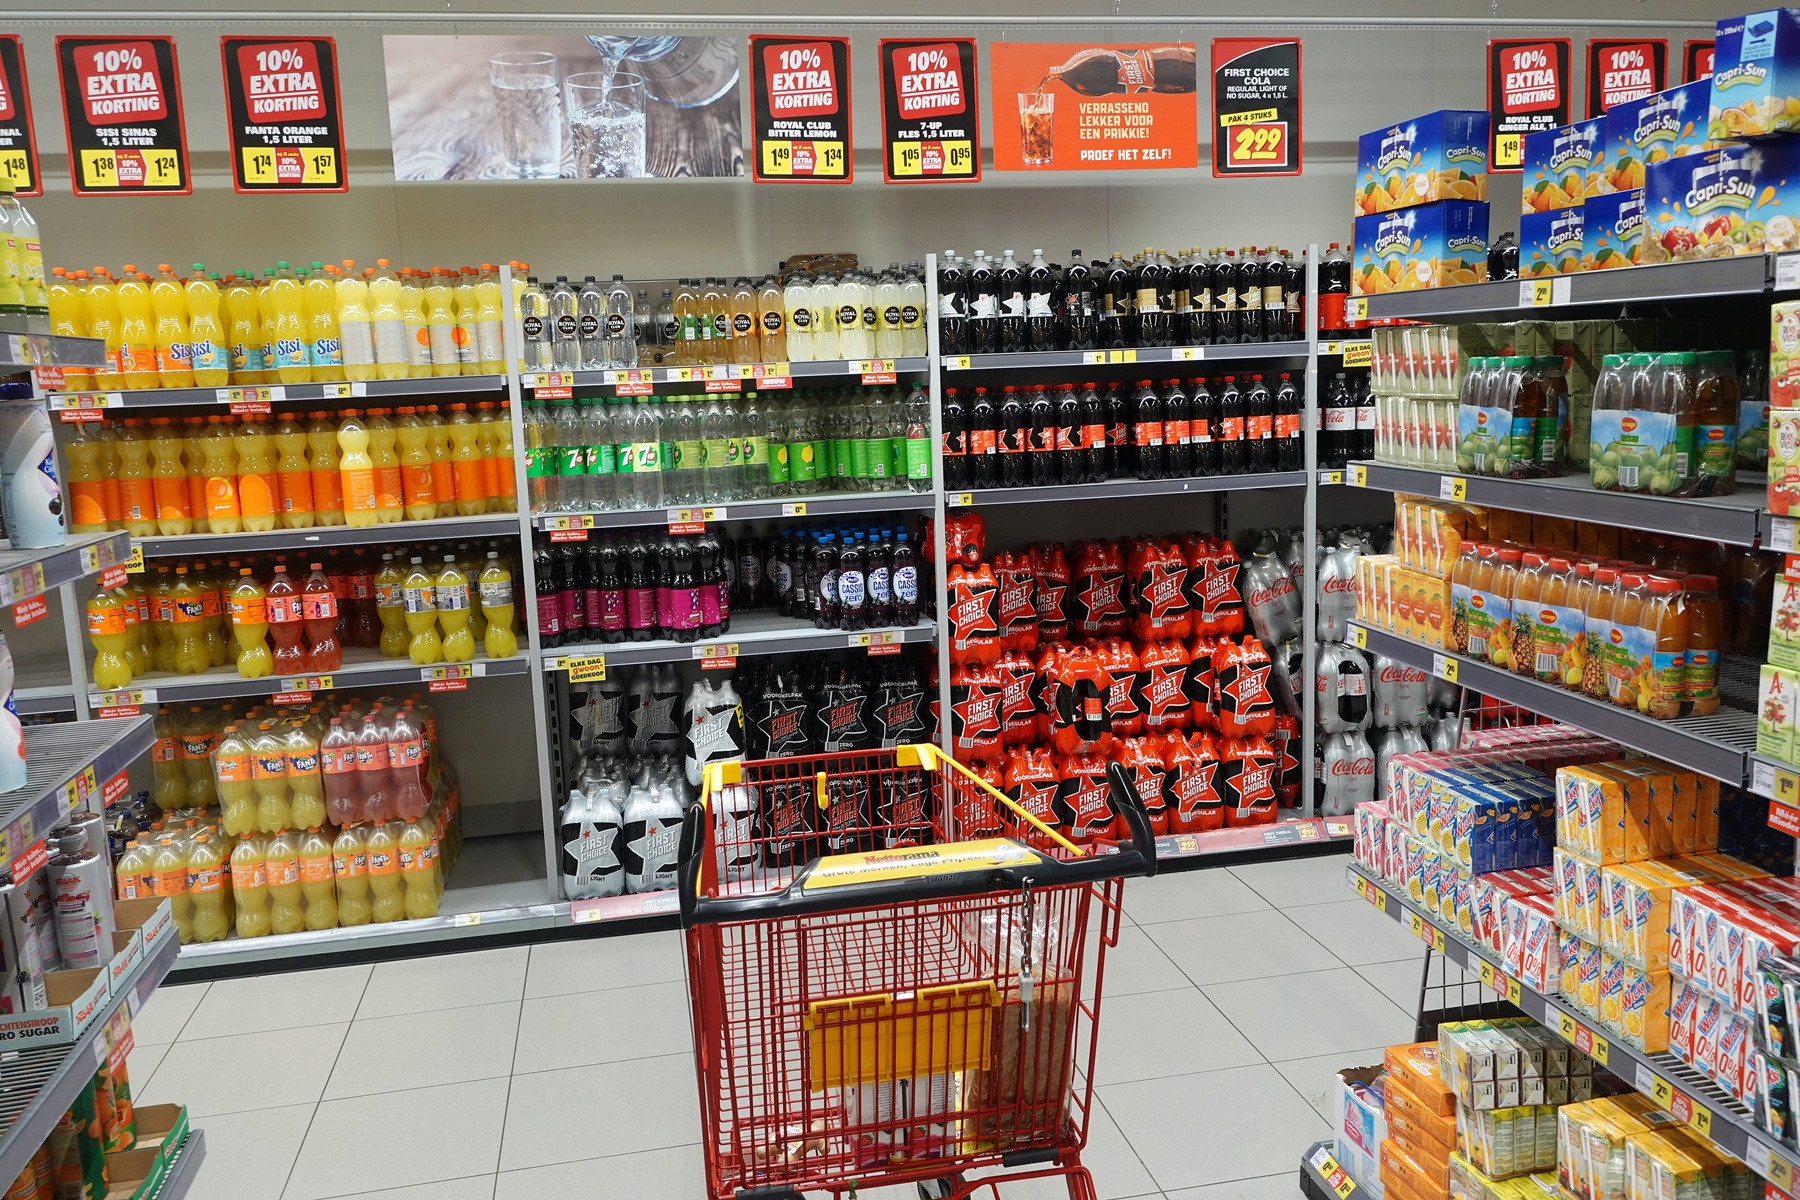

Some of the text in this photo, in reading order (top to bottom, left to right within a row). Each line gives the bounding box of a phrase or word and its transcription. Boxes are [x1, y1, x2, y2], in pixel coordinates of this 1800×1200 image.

[93, 48, 143, 73] 10%
[256, 48, 304, 72] 10%
[779, 48, 821, 70] 10%
[908, 49, 948, 72] 10%
[1512, 49, 1547, 70] 10%
[1611, 49, 1644, 70] 10%
[772, 70, 832, 91] EXTRA
[901, 70, 958, 92] EXTRA
[1224, 68, 1290, 77] FIRST CHOICE
[1244, 77, 1271, 85] COLA
[1505, 68, 1555, 89] EXTRA
[1604, 68, 1651, 89] EXTRA
[1714, 63, 1767, 86] Capri-Sun
[87, 72, 157, 96] EXTRA
[250, 71, 317, 94] EXTRA
[92, 96, 160, 115] KORTING
[254, 95, 319, 114] KORTING
[775, 92, 833, 109] KORTING
[904, 92, 960, 111] KORTING
[1507, 89, 1556, 106] KORTING
[1079, 102, 1149, 114] VERRASSEND
[1250, 111, 1272, 120] STUKS
[773, 121, 832, 130] ROYAL CLUB
[920, 122, 942, 130] 7-UP
[1080, 115, 1153, 126] LEKKER VOOR
[1498, 124, 1528, 132] GINGER
[1532, 115, 1553, 123] CLUB
[95, 127, 158, 137] SISI SINAS
[245, 126, 328, 136] FANTA ORANGE
[768, 129, 837, 138] BITTER LEMON
[898, 129, 965, 139] FLES 1,5 LITER
[1080, 128, 1149, 139] EEN PRIKKIE!
[1634, 114, 1681, 144] Capri-Sun
[101, 137, 154, 147] 1,5 LITER
[262, 135, 313, 145] 1,5 LITER
[1080, 148, 1172, 161] PROEF HET ZELF!
[1377, 145, 1412, 170] Capri-Sun
[1446, 145, 1486, 160] Capri-Sun
[1550, 145, 1593, 169] Capri-Sun
[1685, 175, 1757, 209] Capri-Sun
[1375, 230, 1412, 252] Capri-Sun
[1447, 235, 1486, 248] Capri-Sun
[277, 336, 302, 356] Sisi
[316, 336, 341, 355] Sisi
[841, 584, 863, 594] CASSIS
[1153, 576, 1178, 595] FIRST
[1206, 572, 1230, 591] FIRST
[844, 595, 863, 603] zero
[1001, 585, 1028, 605] FIRST
[1091, 584, 1115, 603] FIRST
[1091, 593, 1116, 611] CHOICE
[1154, 587, 1179, 605] CHOICE
[1207, 583, 1231, 602] CHOICE
[957, 597, 985, 618] FIRST
[1001, 596, 1027, 614] CHOICE
[958, 609, 985, 627] CHOICE
[570, 660, 586, 668] ELKE
[571, 670, 604, 680] GOEDKOOP
[1152, 679, 1178, 697] FIRST
[1153, 690, 1180, 707] CHOICE
[887, 699, 913, 719] FIRST
[694, 717, 724, 740] FIRST
[887, 711, 915, 728] CHOICE
[695, 729, 725, 749] CHOICE
[580, 834, 609, 854] FIRST
[581, 847, 609, 863] CHOICE
[863, 850, 941, 866] Nettorama
[1601, 964, 1624, 996] Wicky
[1623, 977, 1648, 1011] Wicky
[1673, 985, 1697, 1019] Wicky
[19, 1025, 61, 1038] SUGAR
